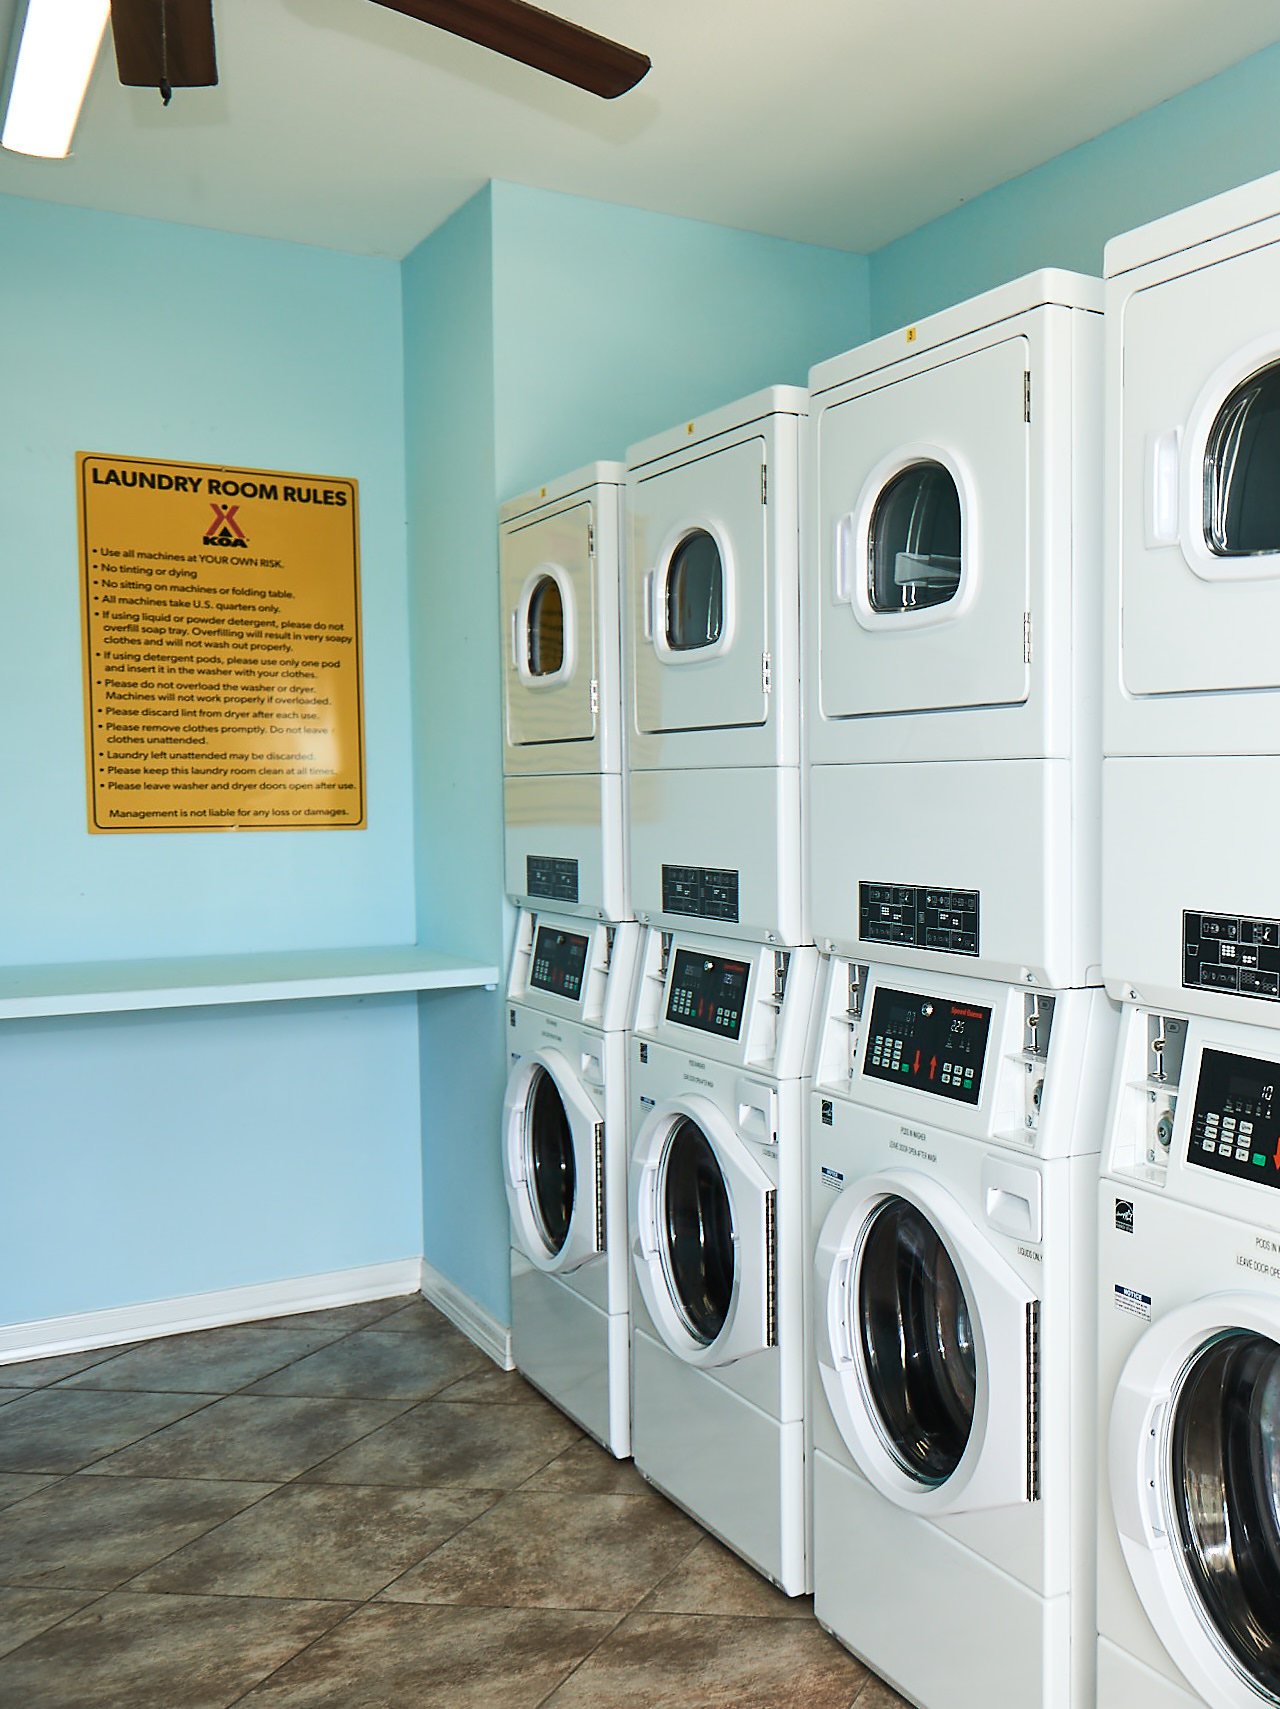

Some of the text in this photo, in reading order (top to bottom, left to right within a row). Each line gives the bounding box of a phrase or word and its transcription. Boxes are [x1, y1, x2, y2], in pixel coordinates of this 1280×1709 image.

[92, 467, 348, 507] LAUNDRY ROOM RULES
[202, 535, 248, 548] KOA
[100, 547, 285, 568] Use all machines at YOUR OWN RISK.
[100, 563, 118, 573] No
[118, 564, 153, 578] tinting
[167, 567, 197, 581] dying
[101, 579, 118, 589] No
[119, 580, 152, 593] sitting
[153, 584, 168, 592] on
[169, 584, 218, 595] machines
[231, 586, 267, 600] folding
[268, 588, 296, 599] table.
[101, 595, 280, 616] All machines take U.S. quarters only.
[102, 609, 344, 631] If using liquid or powder detergent, please do not
[102, 623, 139, 633] overfill
[140, 626, 167, 637] soap
[167, 625, 189, 638] tray.
[191, 626, 244, 640] Overfilling
[245, 629, 263, 639] will
[264, 631, 291, 640] result
[103, 635, 293, 654] clothes and will not wash out properly.
[103, 651, 340, 670] If using detergent pods, please use only one pod
[104, 663, 279, 679] and insert it in the washer with your
[104, 679, 275, 693] Please do not overload the washer
[105, 691, 265, 706] Machines will not work properly
[105, 707, 250, 721] Please discard lint from dryer
[105, 722, 140, 732] Please
[182, 723, 219, 733] clothes
[220, 724, 267, 736] promptly.
[106, 735, 209, 745] clothes unattended.
[106, 750, 250, 762] Laundry left unattended may
[107, 765, 141, 775] Please
[142, 765, 169, 777] keep
[170, 765, 189, 775] this
[190, 766, 228, 777] laundry
[257, 766, 284, 775] clean
[107, 780, 142, 789] Please
[143, 780, 171, 790] leave
[172, 780, 209, 790] washer
[210, 780, 230, 790] and
[230, 780, 257, 792] dryer
[258, 781, 287, 790] doors
[109, 807, 178, 819] Management
[179, 807, 188, 817] is
[189, 807, 207, 817] not
[208, 807, 236, 816] liable
[236, 807, 251, 816] for
[252, 809, 270, 818] any
[271, 807, 290, 816] loss
[303, 807, 349, 818] damages.
